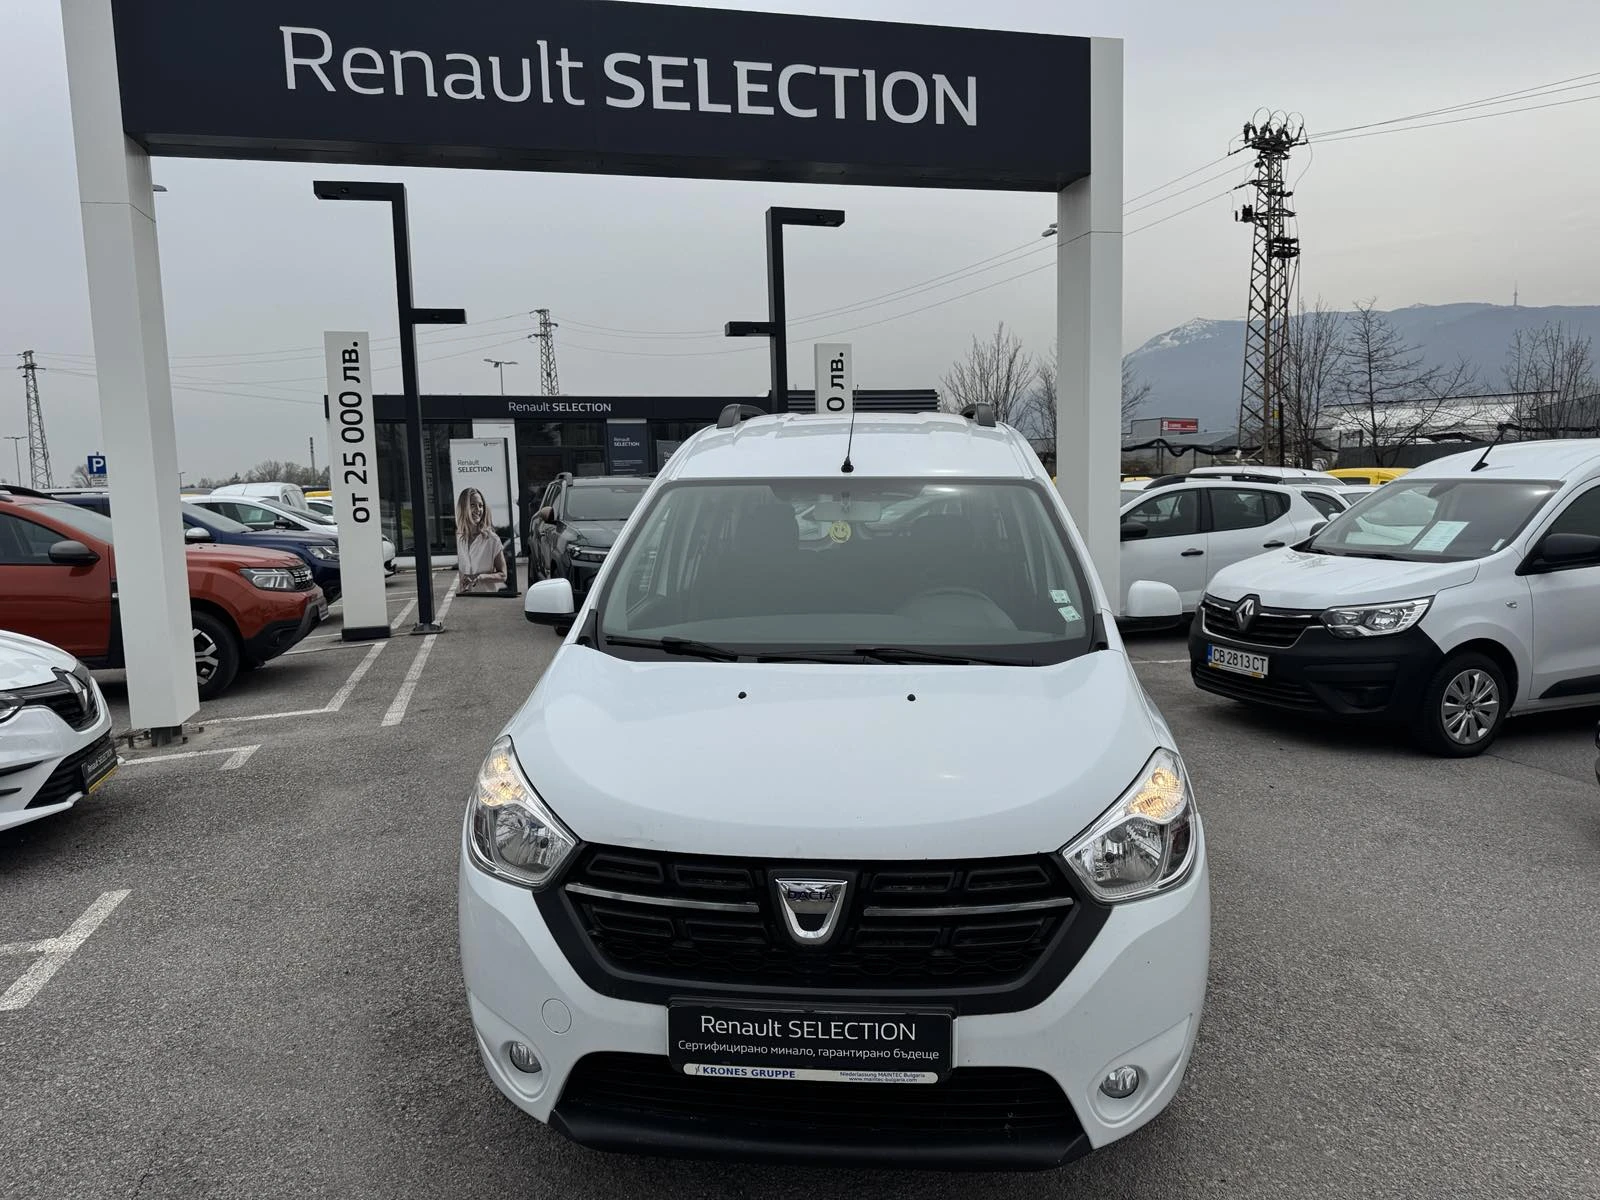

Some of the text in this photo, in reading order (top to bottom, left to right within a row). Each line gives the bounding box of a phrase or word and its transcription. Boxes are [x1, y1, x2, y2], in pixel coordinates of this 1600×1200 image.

[279, 25, 978, 127] Renault SELECTION
[342, 341, 361, 384] лв.
[830, 352, 845, 390] лв.
[338, 391, 365, 443] 000
[508, 402, 612, 412] Renault SELECTION
[92, 458, 105, 472] P
[343, 451, 368, 485] 25
[1214, 649, 1266, 672] CB 2813 CT
[788, 890, 835, 901] DACIA
[700, 1015, 917, 1041] Renault SELECTION
[678, 1040, 940, 1061] Сертифицирано минало, гарантирано бъдеще
[702, 1066, 796, 1079] KRONES GRUPPE
